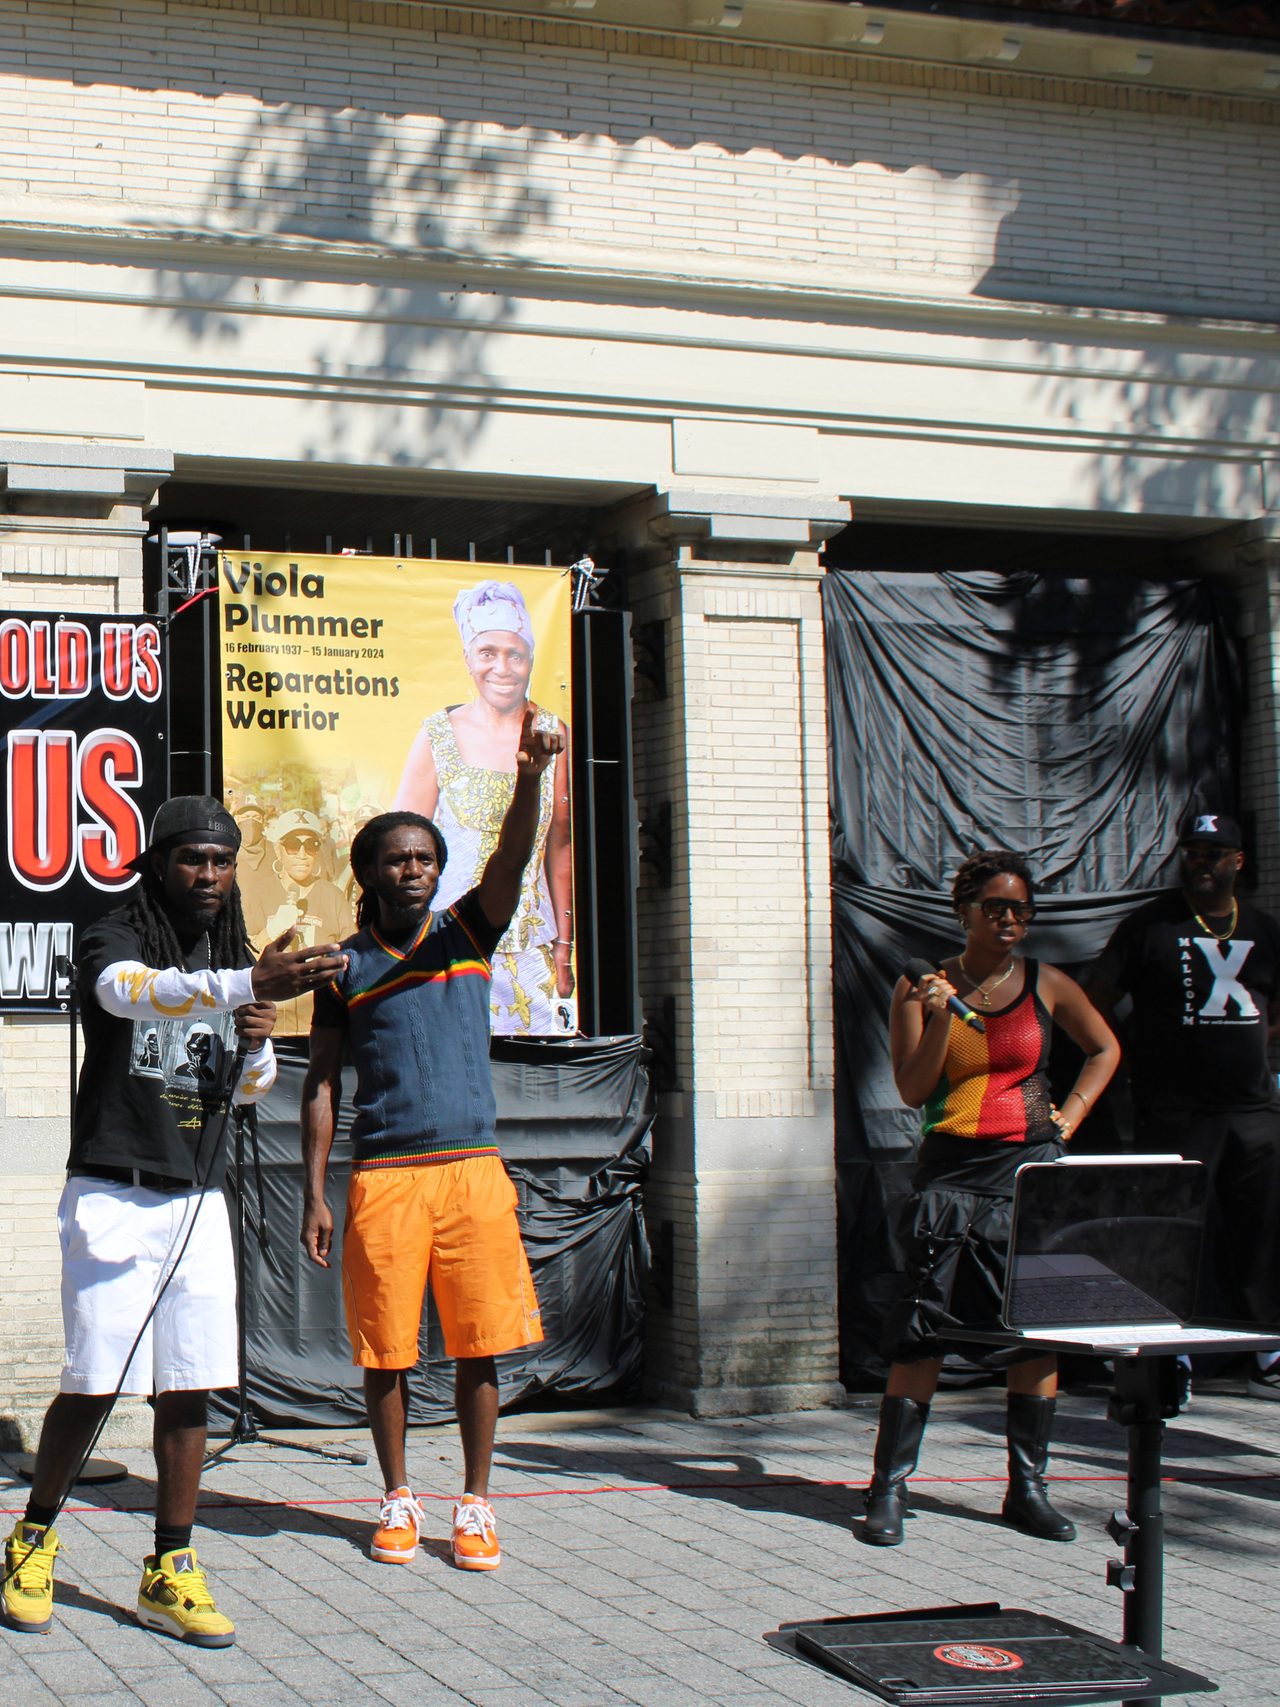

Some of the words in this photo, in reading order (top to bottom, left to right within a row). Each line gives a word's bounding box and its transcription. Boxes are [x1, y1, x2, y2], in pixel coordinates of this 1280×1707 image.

[222, 561, 325, 598] Viola
[224, 603, 384, 638] Plummer
[100, 623, 162, 702] US
[225, 642, 235, 653] 16
[237, 643, 279, 655] February
[281, 644, 302, 655] 1937
[311, 646, 322, 656] 15
[323, 646, 360, 659] January
[361, 648, 384, 659] 2024
[226, 663, 400, 698] Reparations
[226, 700, 340, 731] Warrior
[6, 728, 146, 892] US
[1193, 937, 1260, 1017] X
